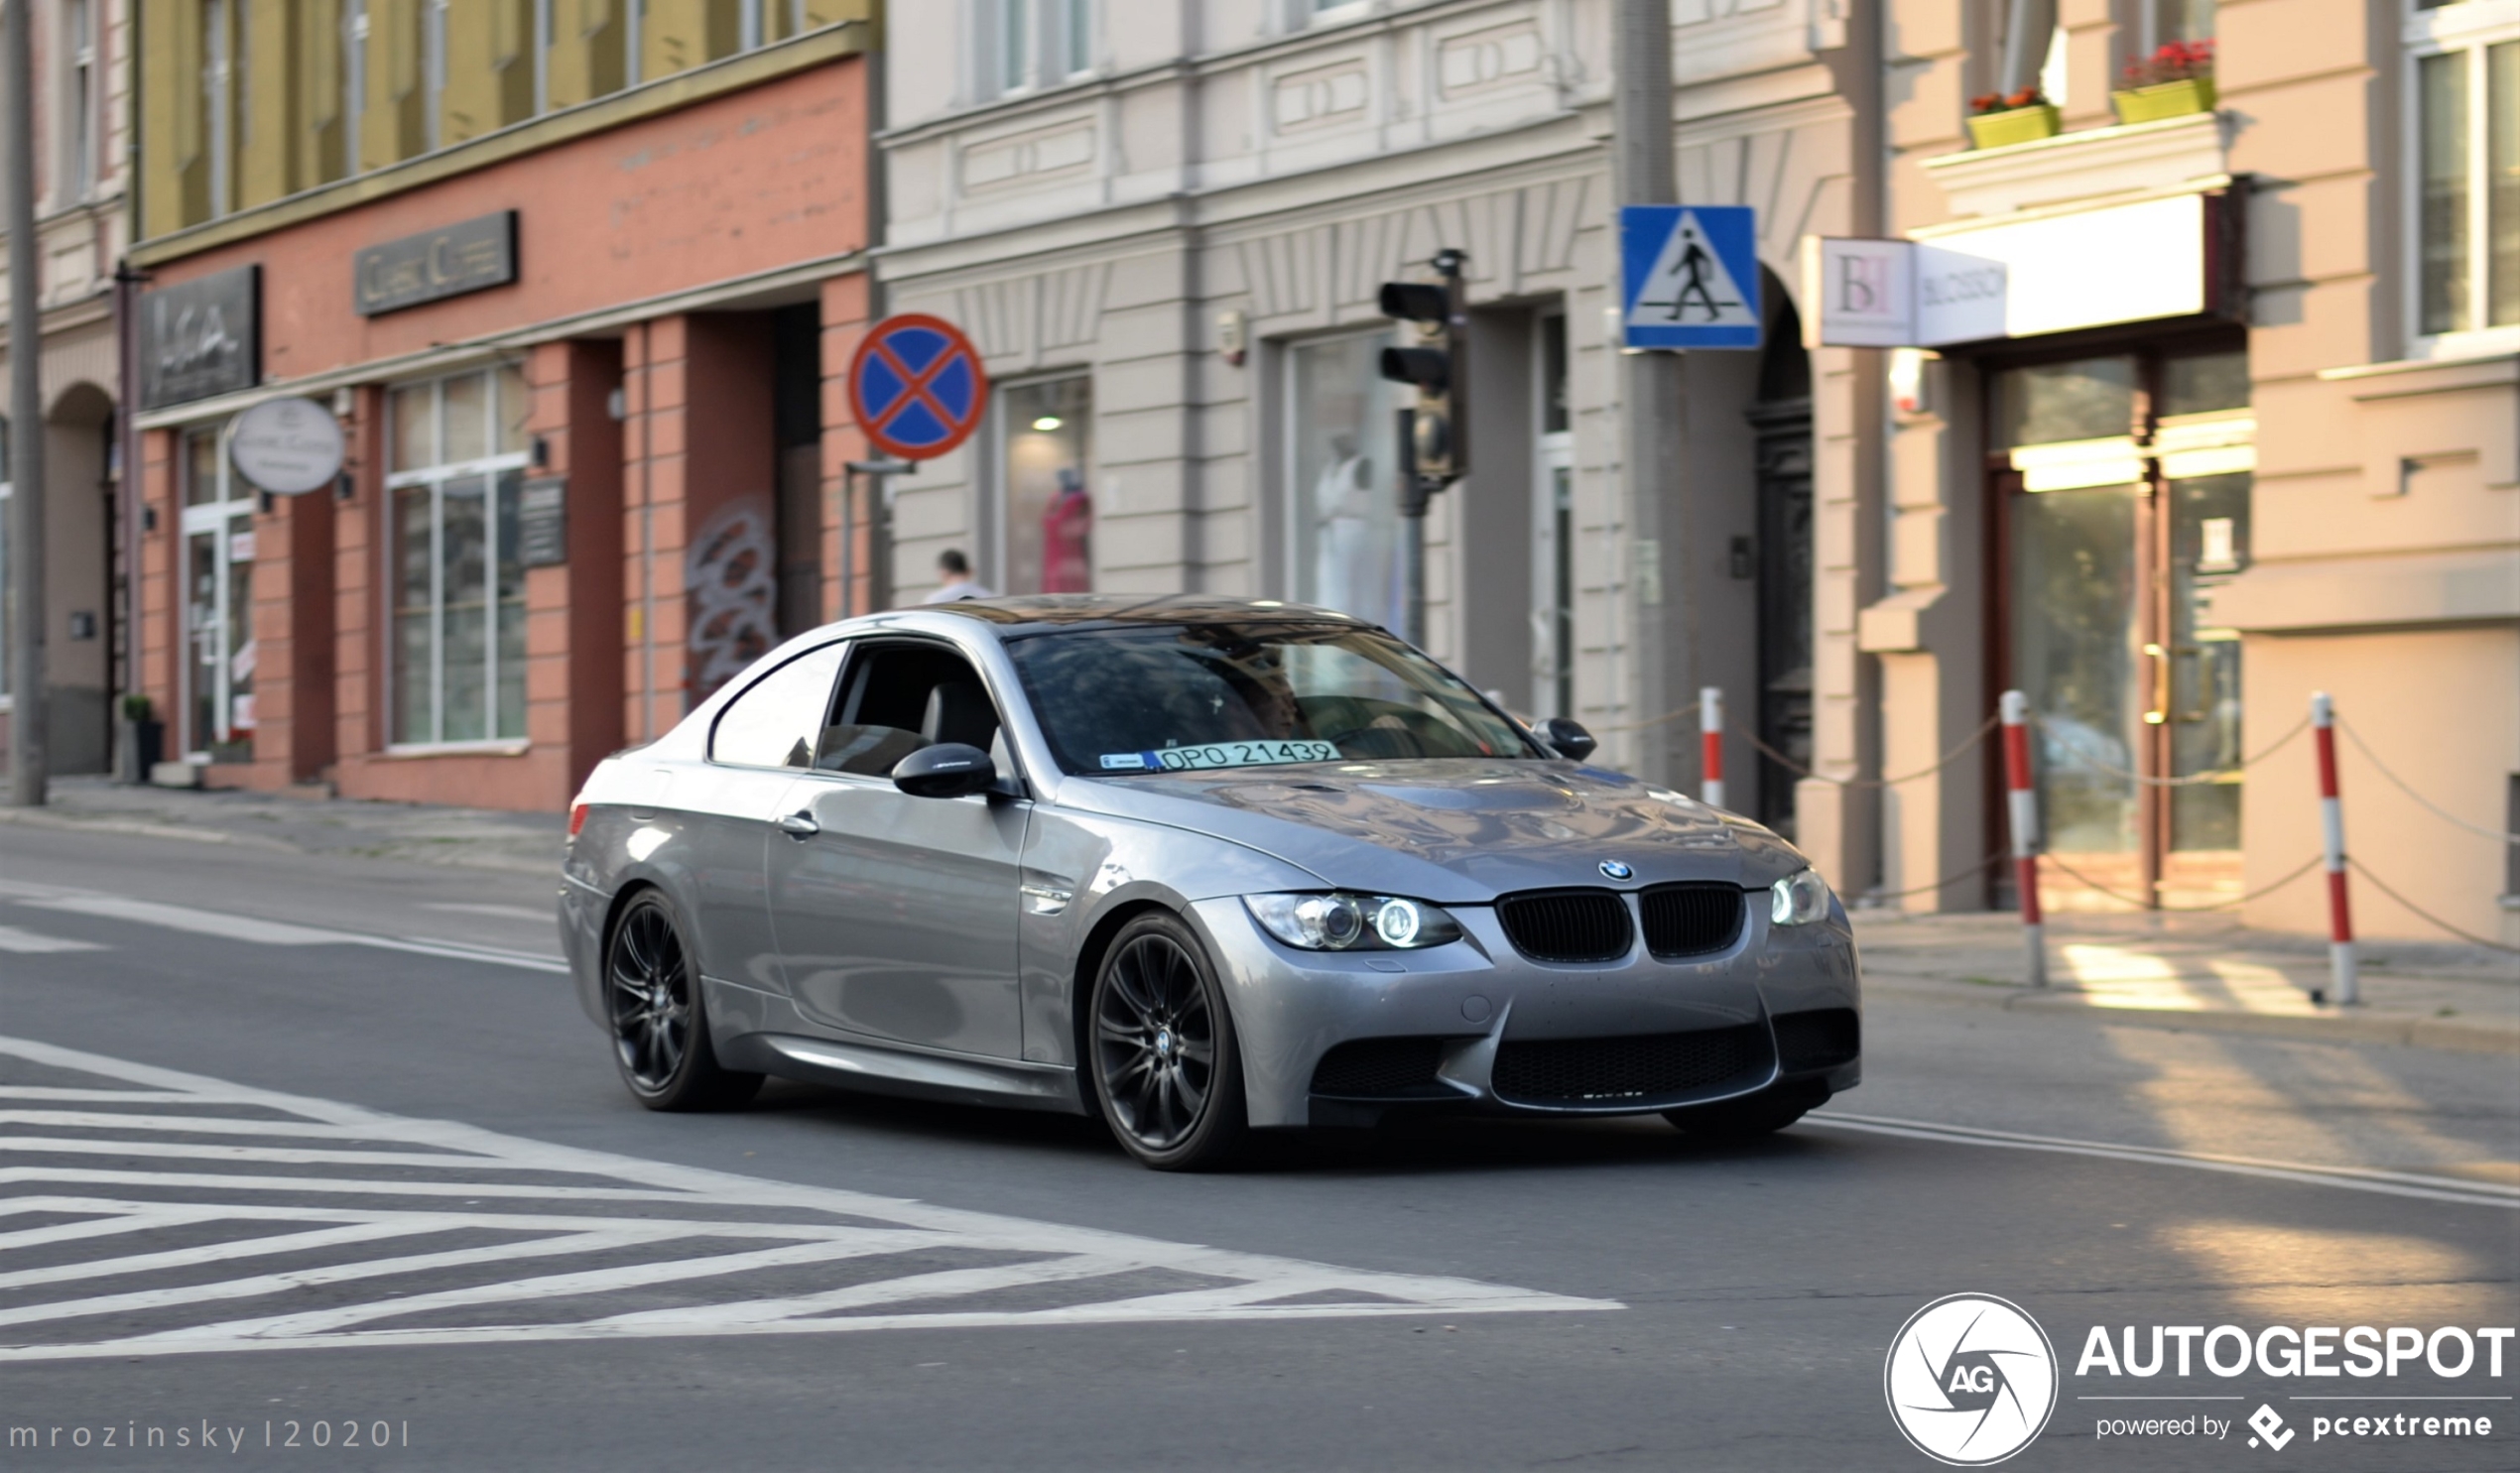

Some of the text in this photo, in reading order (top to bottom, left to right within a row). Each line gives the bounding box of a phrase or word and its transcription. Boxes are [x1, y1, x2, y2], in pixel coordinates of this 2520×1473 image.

[1923, 266, 2007, 307] BLOSSO
[1162, 743, 1331, 770] OPO 21439
